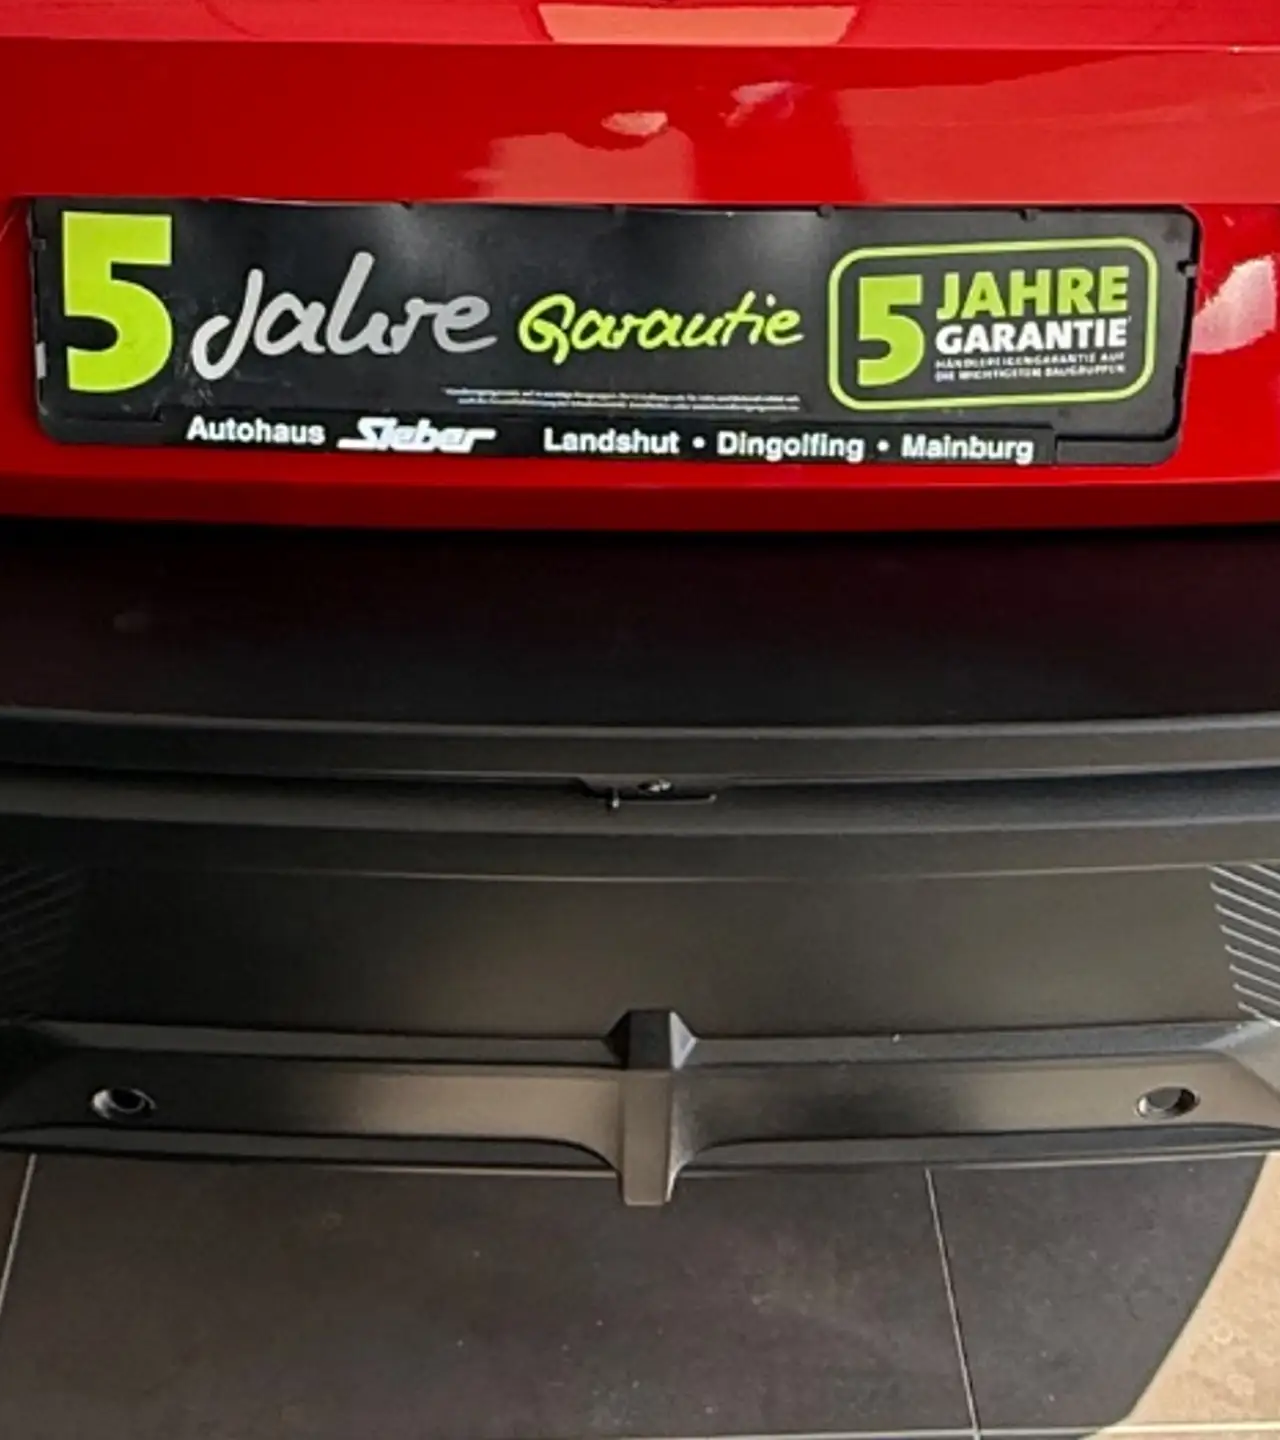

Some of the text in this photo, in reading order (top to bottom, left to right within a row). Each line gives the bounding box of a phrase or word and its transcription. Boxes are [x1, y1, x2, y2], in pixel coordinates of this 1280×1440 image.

[62, 211, 805, 392] 5 Jahre Garantie
[858, 265, 1129, 385] 5 JAHRE
[187, 416, 325, 445] Autohaus
[544, 427, 680, 454] Landshut
[718, 432, 865, 462] Dingolfing
[901, 435, 1034, 464] Mainburg
